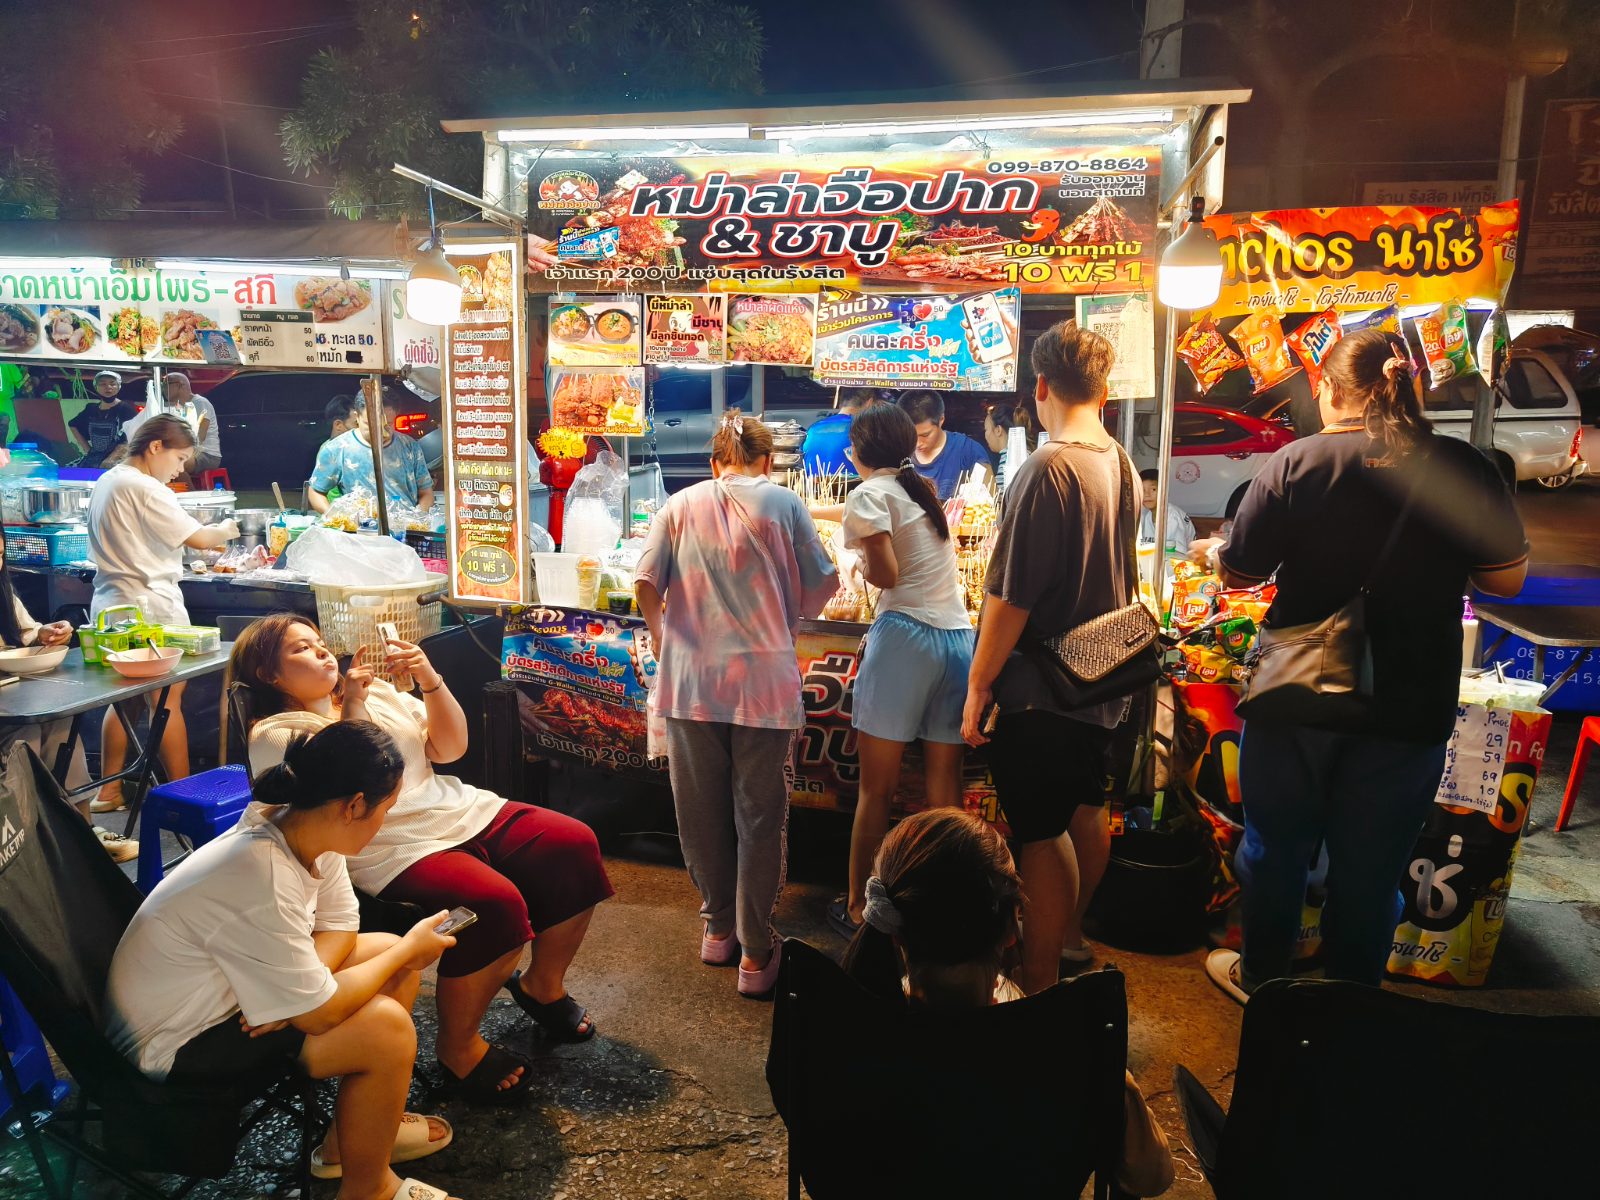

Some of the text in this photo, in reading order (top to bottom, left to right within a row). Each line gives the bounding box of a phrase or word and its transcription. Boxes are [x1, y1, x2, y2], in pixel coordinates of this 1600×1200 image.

[986, 158, 1147, 173] 099-870-8864
[1060, 174, 1145, 187] รับออกงาน
[630, 166, 1040, 217] หม่าล่าจือปาก
[702, 218, 899, 268] & ชาบู
[1003, 240, 1142, 259] 10 บาททุกไม้
[545, 265, 613, 281] เจ้าแรก
[1002, 261, 1142, 283] 10 ฟรี 1
[651, 299, 692, 310] มีหม่าล่า
[817, 294, 868, 321] ร้านนี้
[817, 311, 894, 334] เข้าร่วมโครงการ
[332, 334, 356, 345] ทะเล
[651, 328, 704, 342] มีลูกชิ้นทอด
[847, 325, 942, 350] คนละครึ่ง
[820, 357, 958, 377] บัตรสวัสดิการแห่งรัฐ
[1486, 733, 1503, 748] 29
[1482, 770, 1498, 783] 69
[1479, 784, 1495, 796] 10
